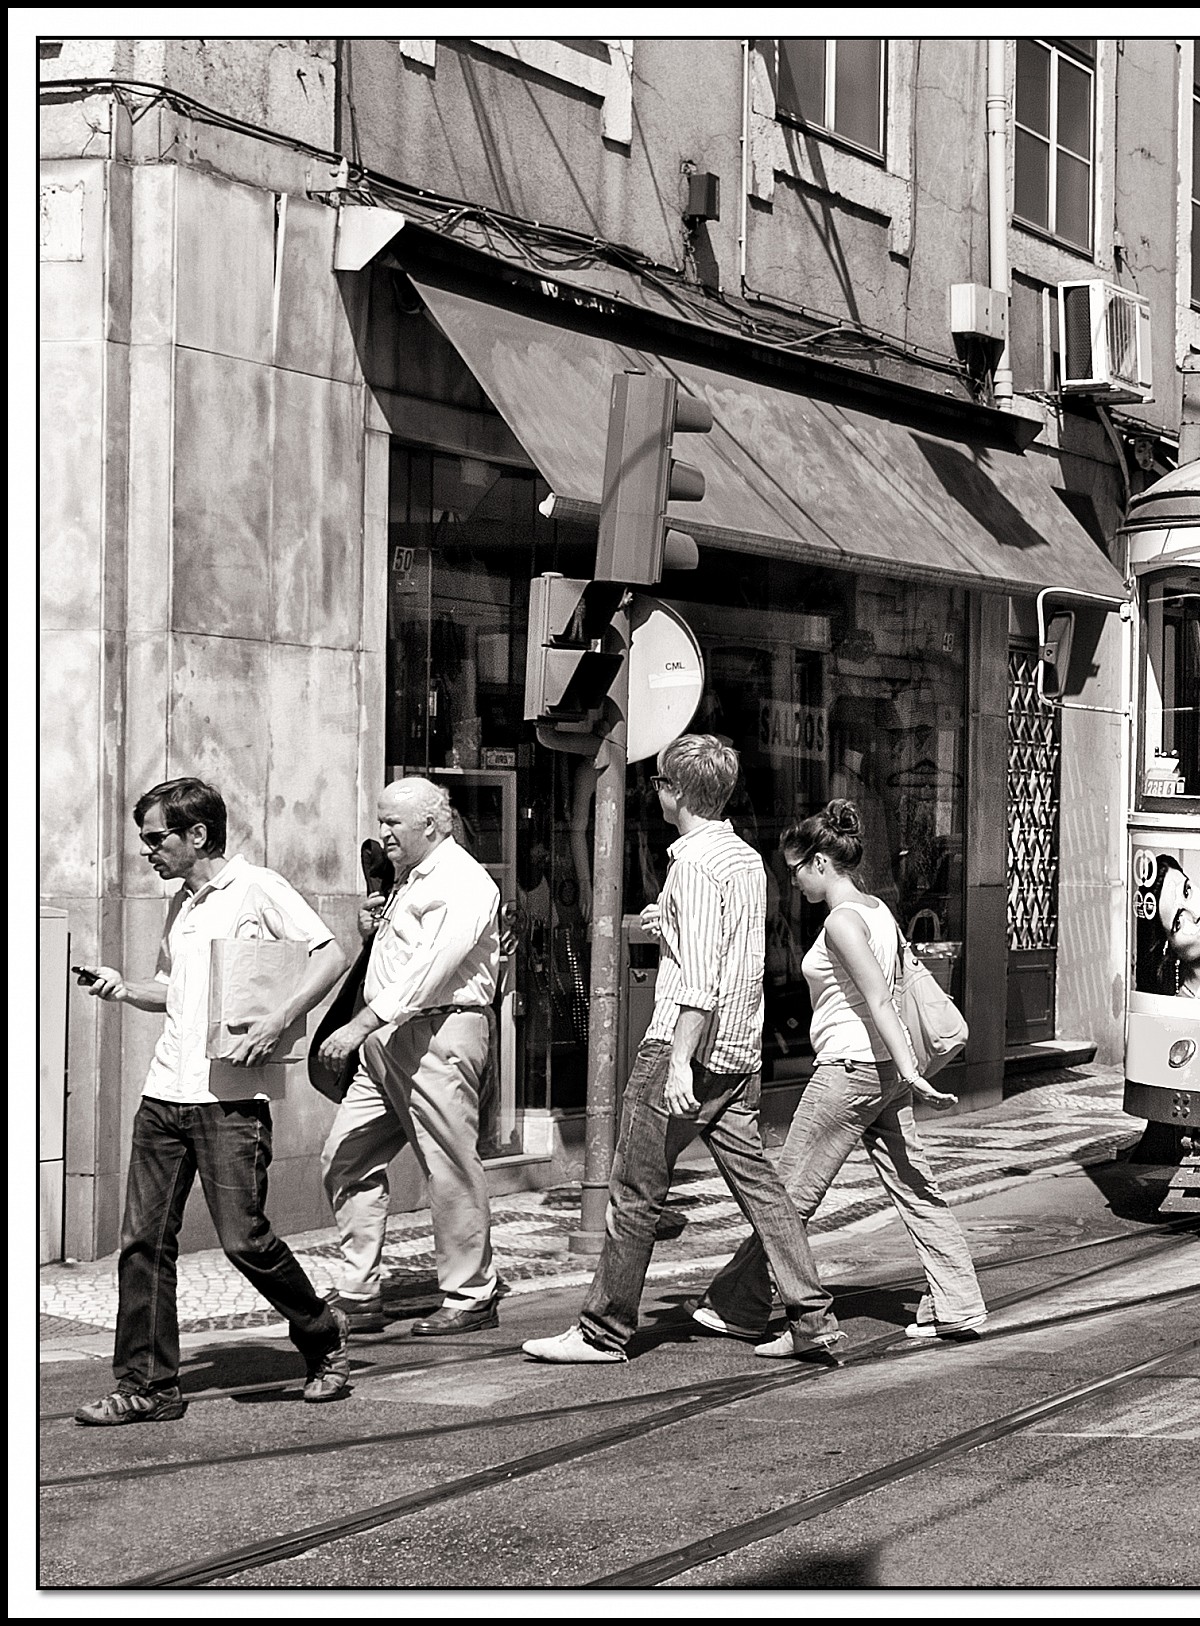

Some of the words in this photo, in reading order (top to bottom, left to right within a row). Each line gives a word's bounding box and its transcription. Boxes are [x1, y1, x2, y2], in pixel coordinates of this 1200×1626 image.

[395, 549, 412, 570] 50
[665, 662, 685, 671] CML
[760, 706, 825, 752] SALDOS
